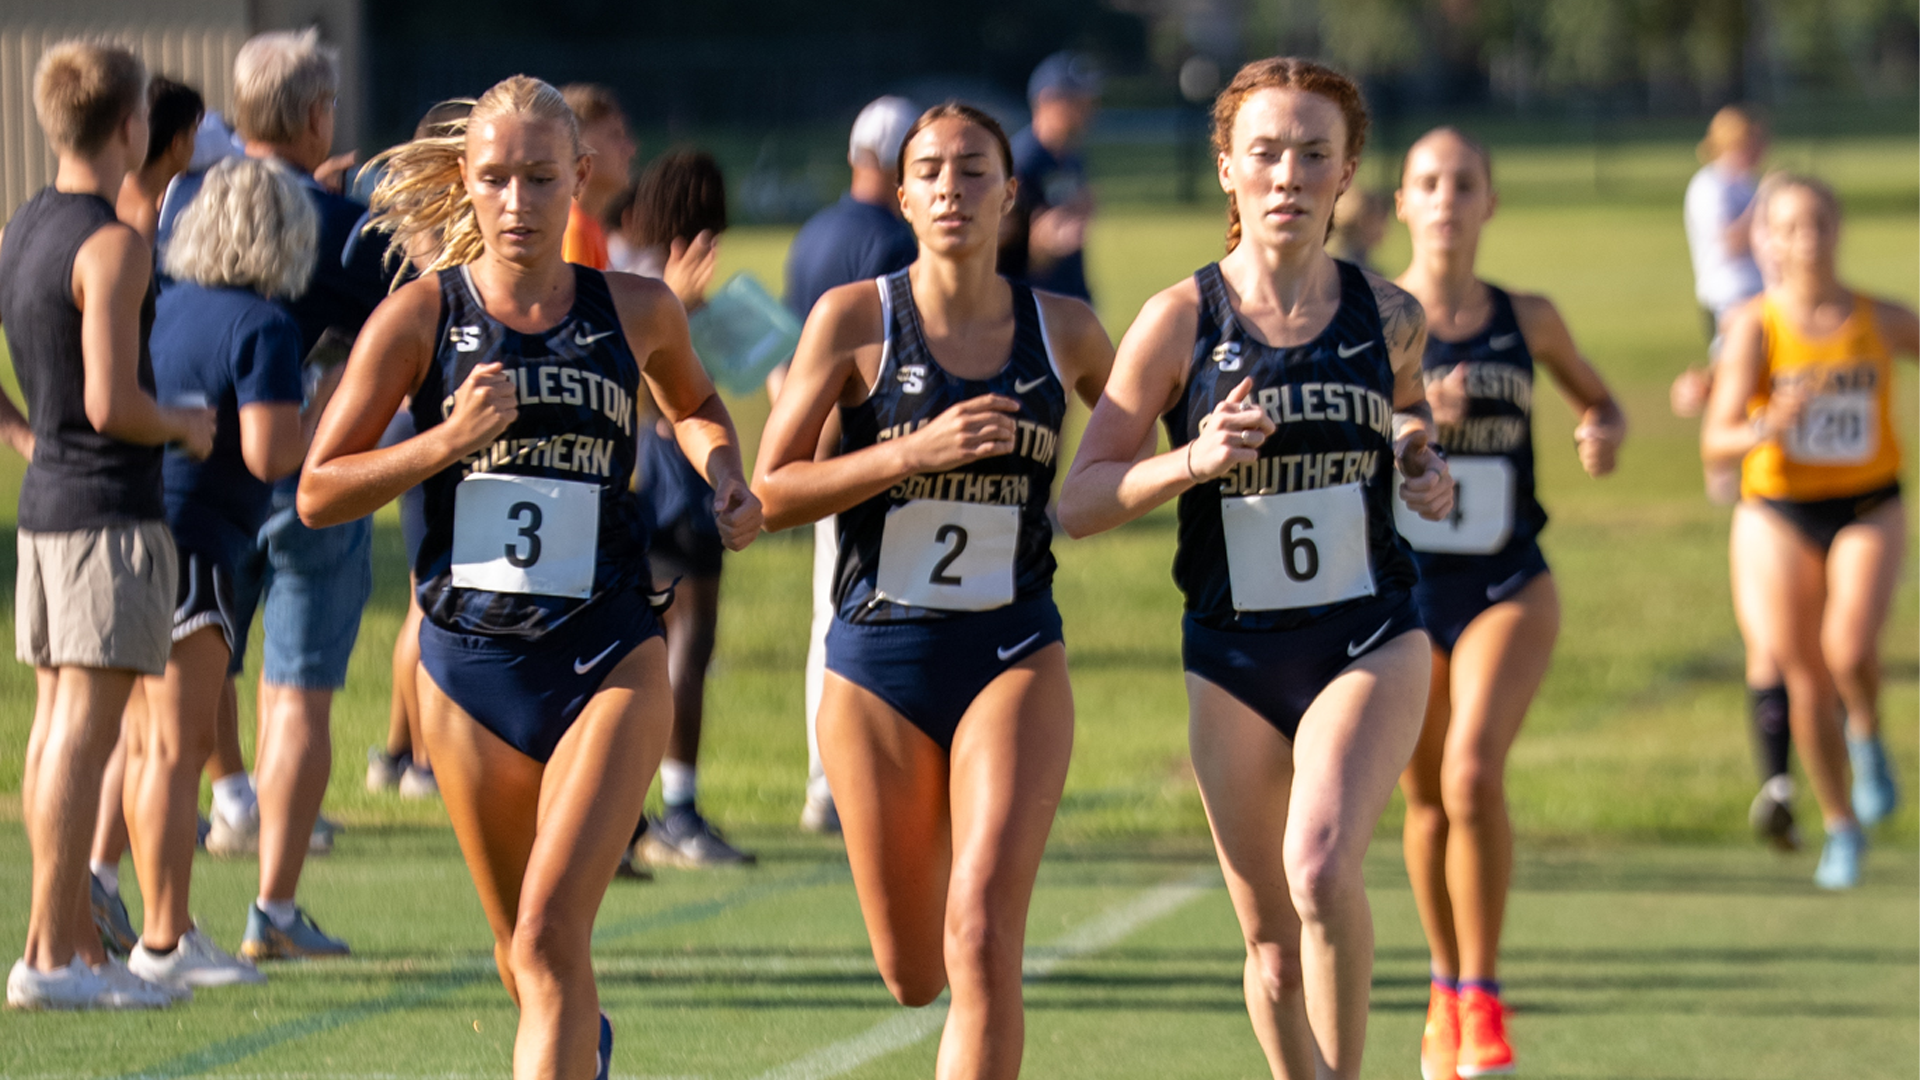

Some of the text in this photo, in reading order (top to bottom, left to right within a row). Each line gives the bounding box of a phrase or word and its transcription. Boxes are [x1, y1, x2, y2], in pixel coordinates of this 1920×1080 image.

[504, 501, 543, 568] 3
[929, 524, 968, 586] 2
[1279, 516, 1318, 582] 6
